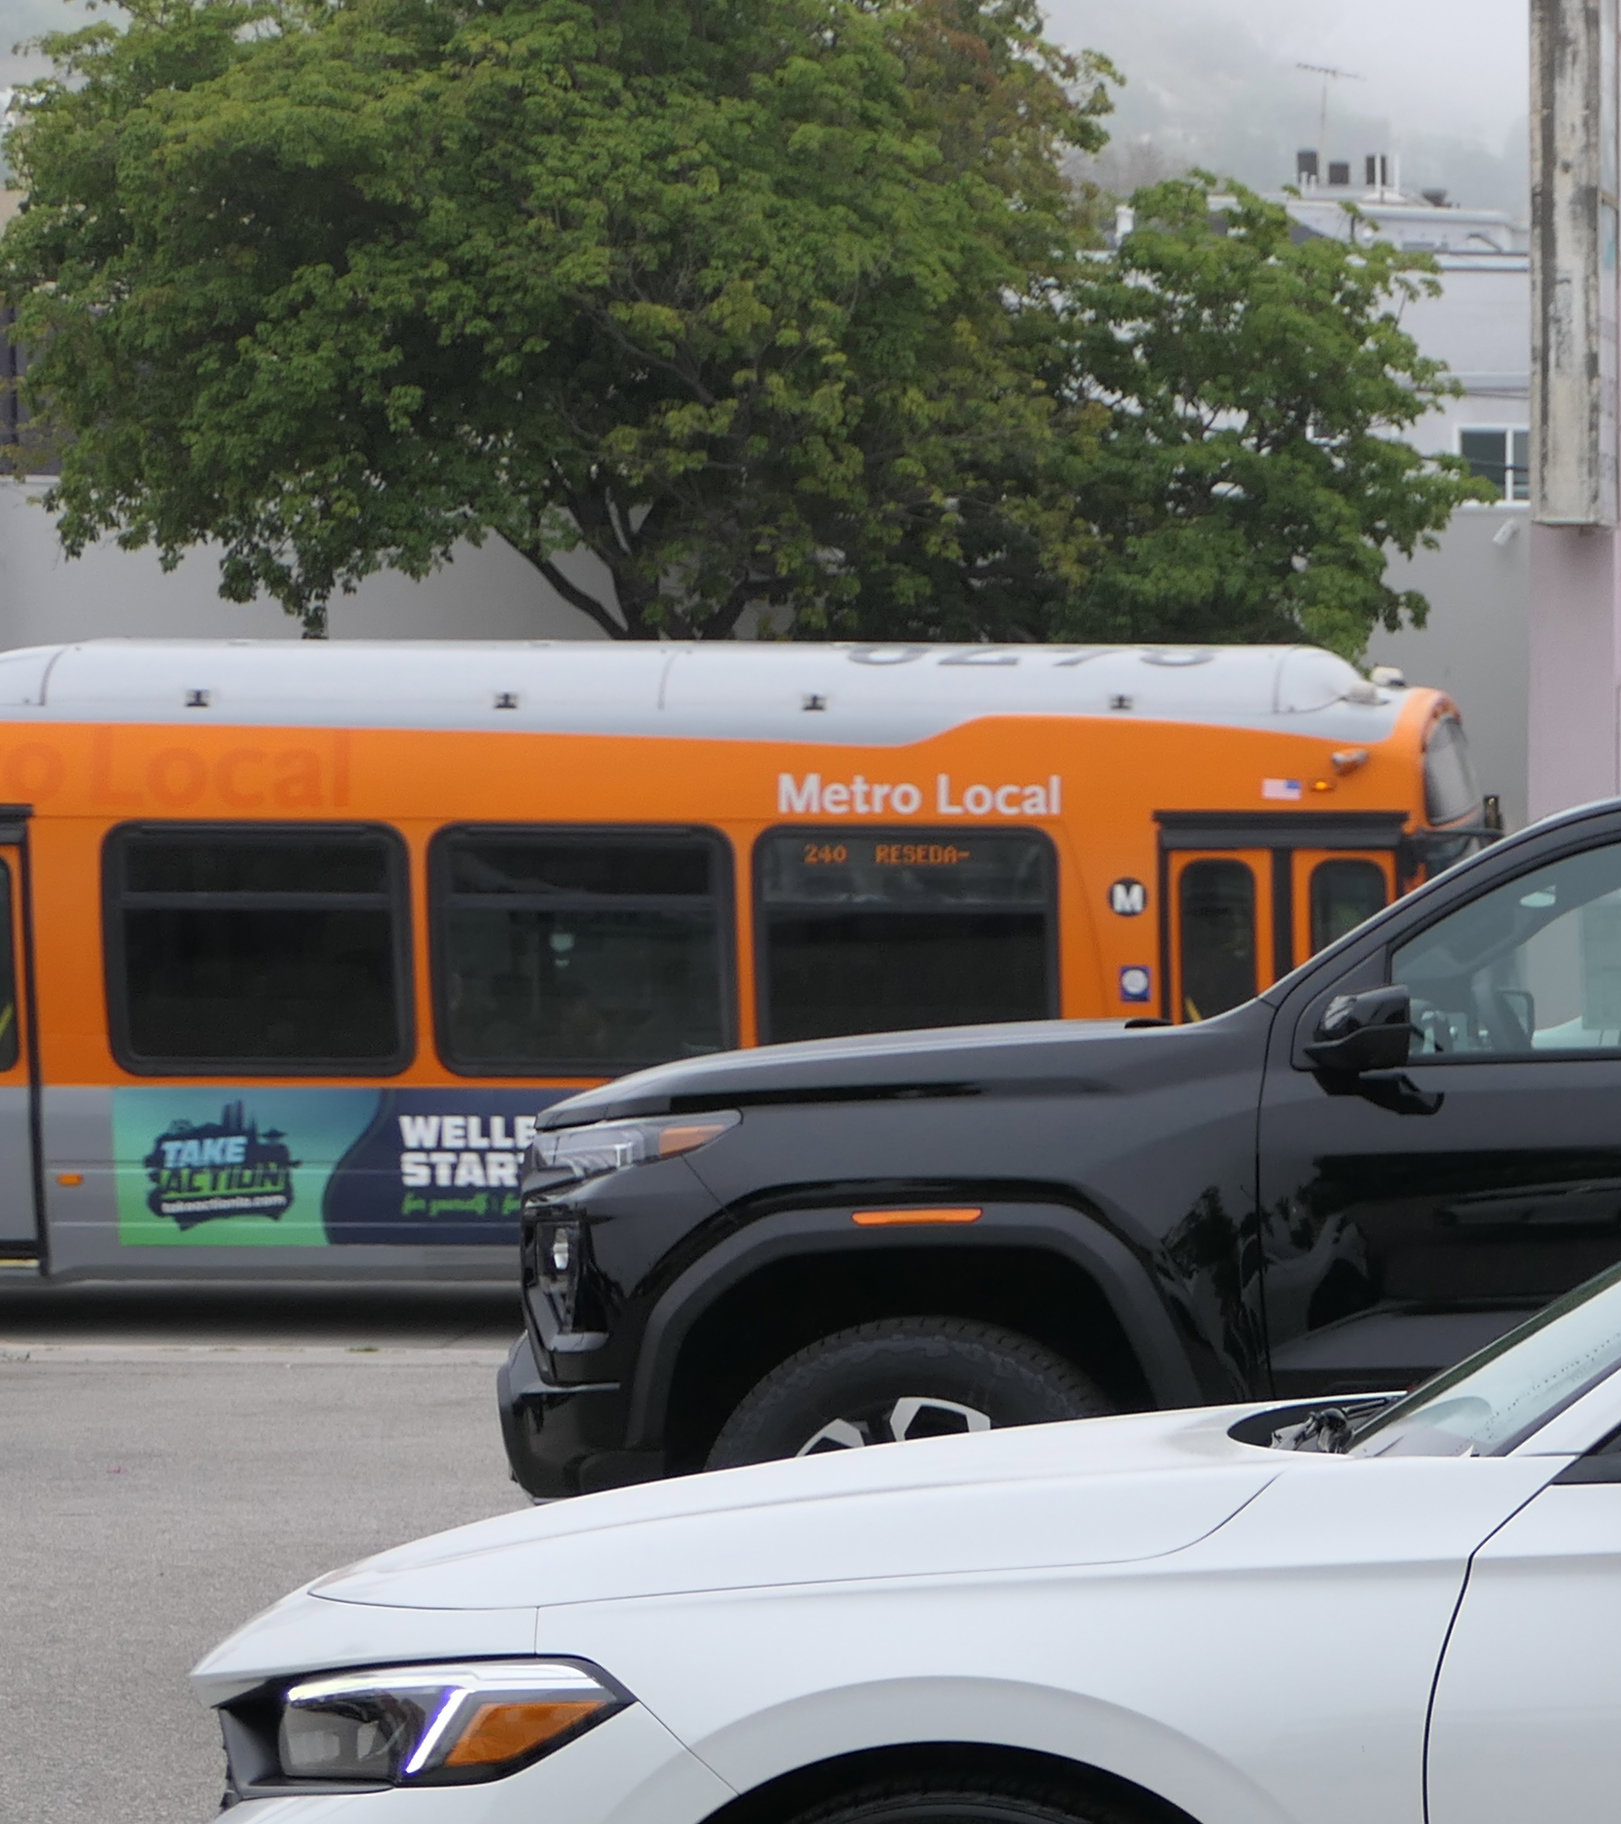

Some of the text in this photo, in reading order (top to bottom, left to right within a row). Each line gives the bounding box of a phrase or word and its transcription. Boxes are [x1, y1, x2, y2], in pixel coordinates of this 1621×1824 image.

[92, 725, 351, 809] Local
[777, 772, 1062, 816] Metro Local
[803, 844, 849, 864] 240
[399, 1115, 537, 1149] WELLE
[160, 1135, 249, 1169] TAKE
